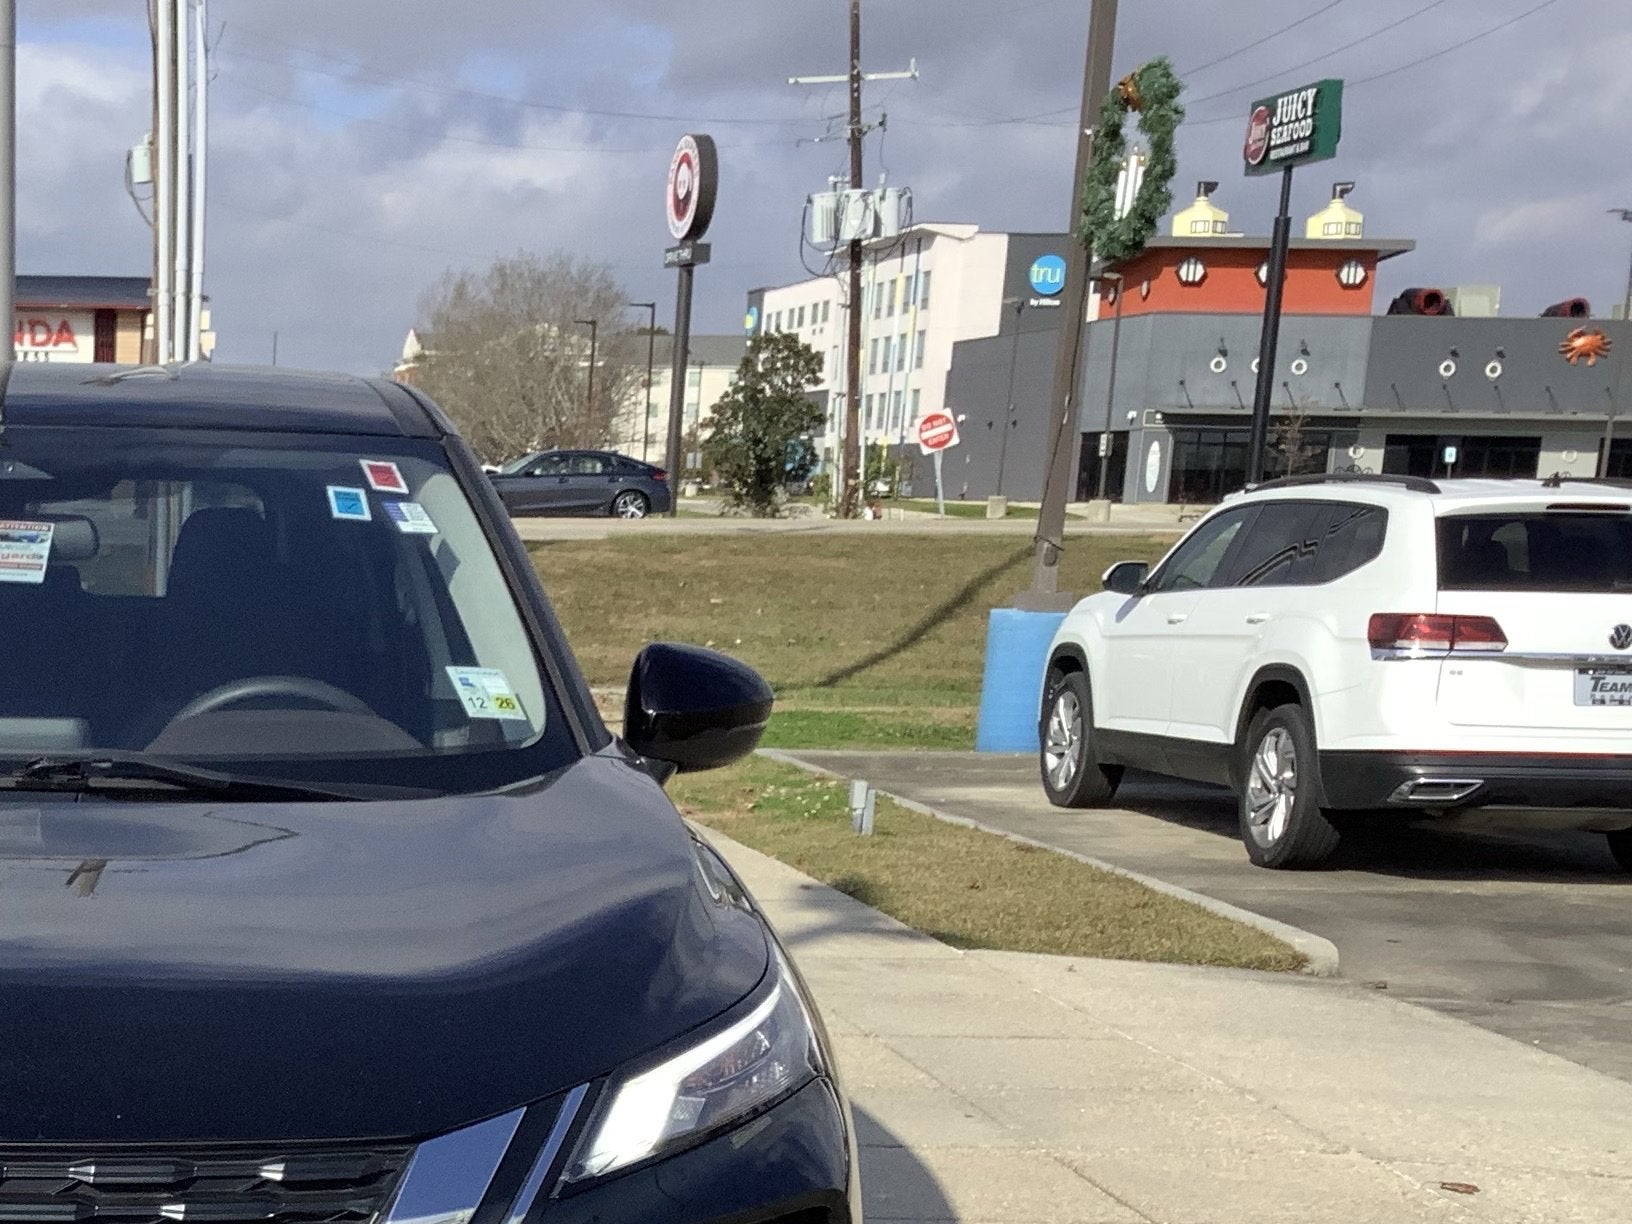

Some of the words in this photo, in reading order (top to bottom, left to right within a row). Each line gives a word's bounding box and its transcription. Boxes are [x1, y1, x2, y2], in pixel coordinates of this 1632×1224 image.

[1272, 88, 1317, 126] JUICY
[1270, 118, 1313, 146] SEAFOOD
[1031, 262, 1061, 284] tru
[921, 421, 932, 431] DO
[932, 416, 947, 427] NOT
[927, 433, 950, 446] ENTER
[468, 697, 488, 709] 12
[495, 697, 516, 710] 26
